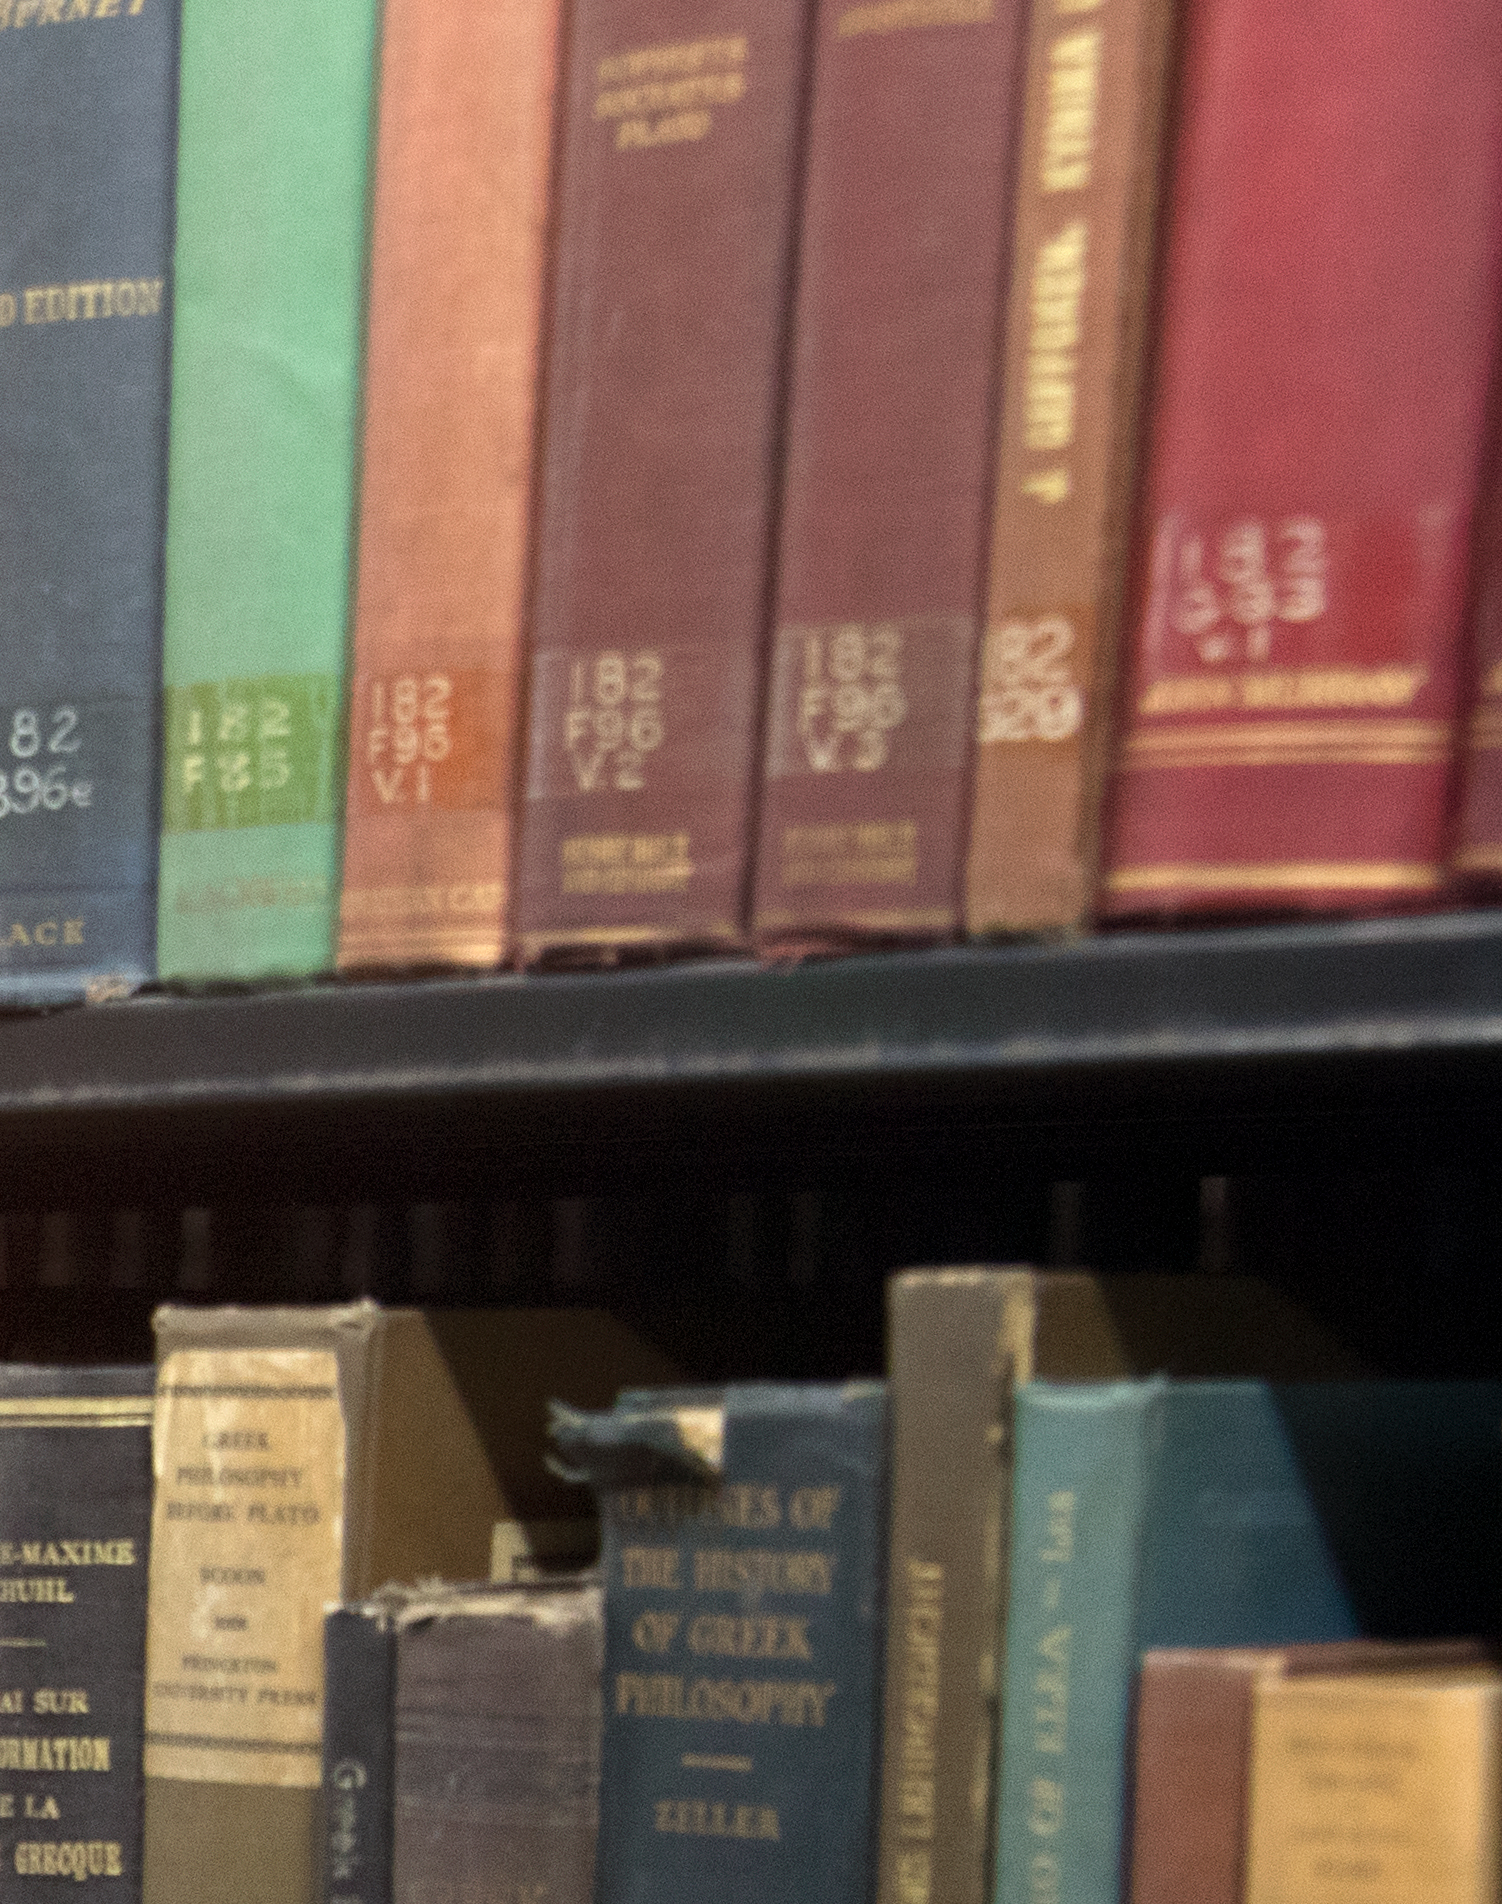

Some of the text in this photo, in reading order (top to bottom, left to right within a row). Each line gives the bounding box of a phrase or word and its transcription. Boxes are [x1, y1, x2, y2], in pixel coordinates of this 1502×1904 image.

[24, 279, 164, 323] EDITION
[372, 674, 452, 719] 182
[569, 650, 663, 703] 182
[186, 702, 290, 743] 182
[248, 1502, 320, 1525] PLATO
[687, 1617, 813, 1662] GREEK
[33, 1689, 90, 1714] SUR
[616, 1674, 837, 1728] PHILOSOPHY
[25, 1795, 61, 1820] LA
[14, 1839, 122, 1882] GRECQUE
